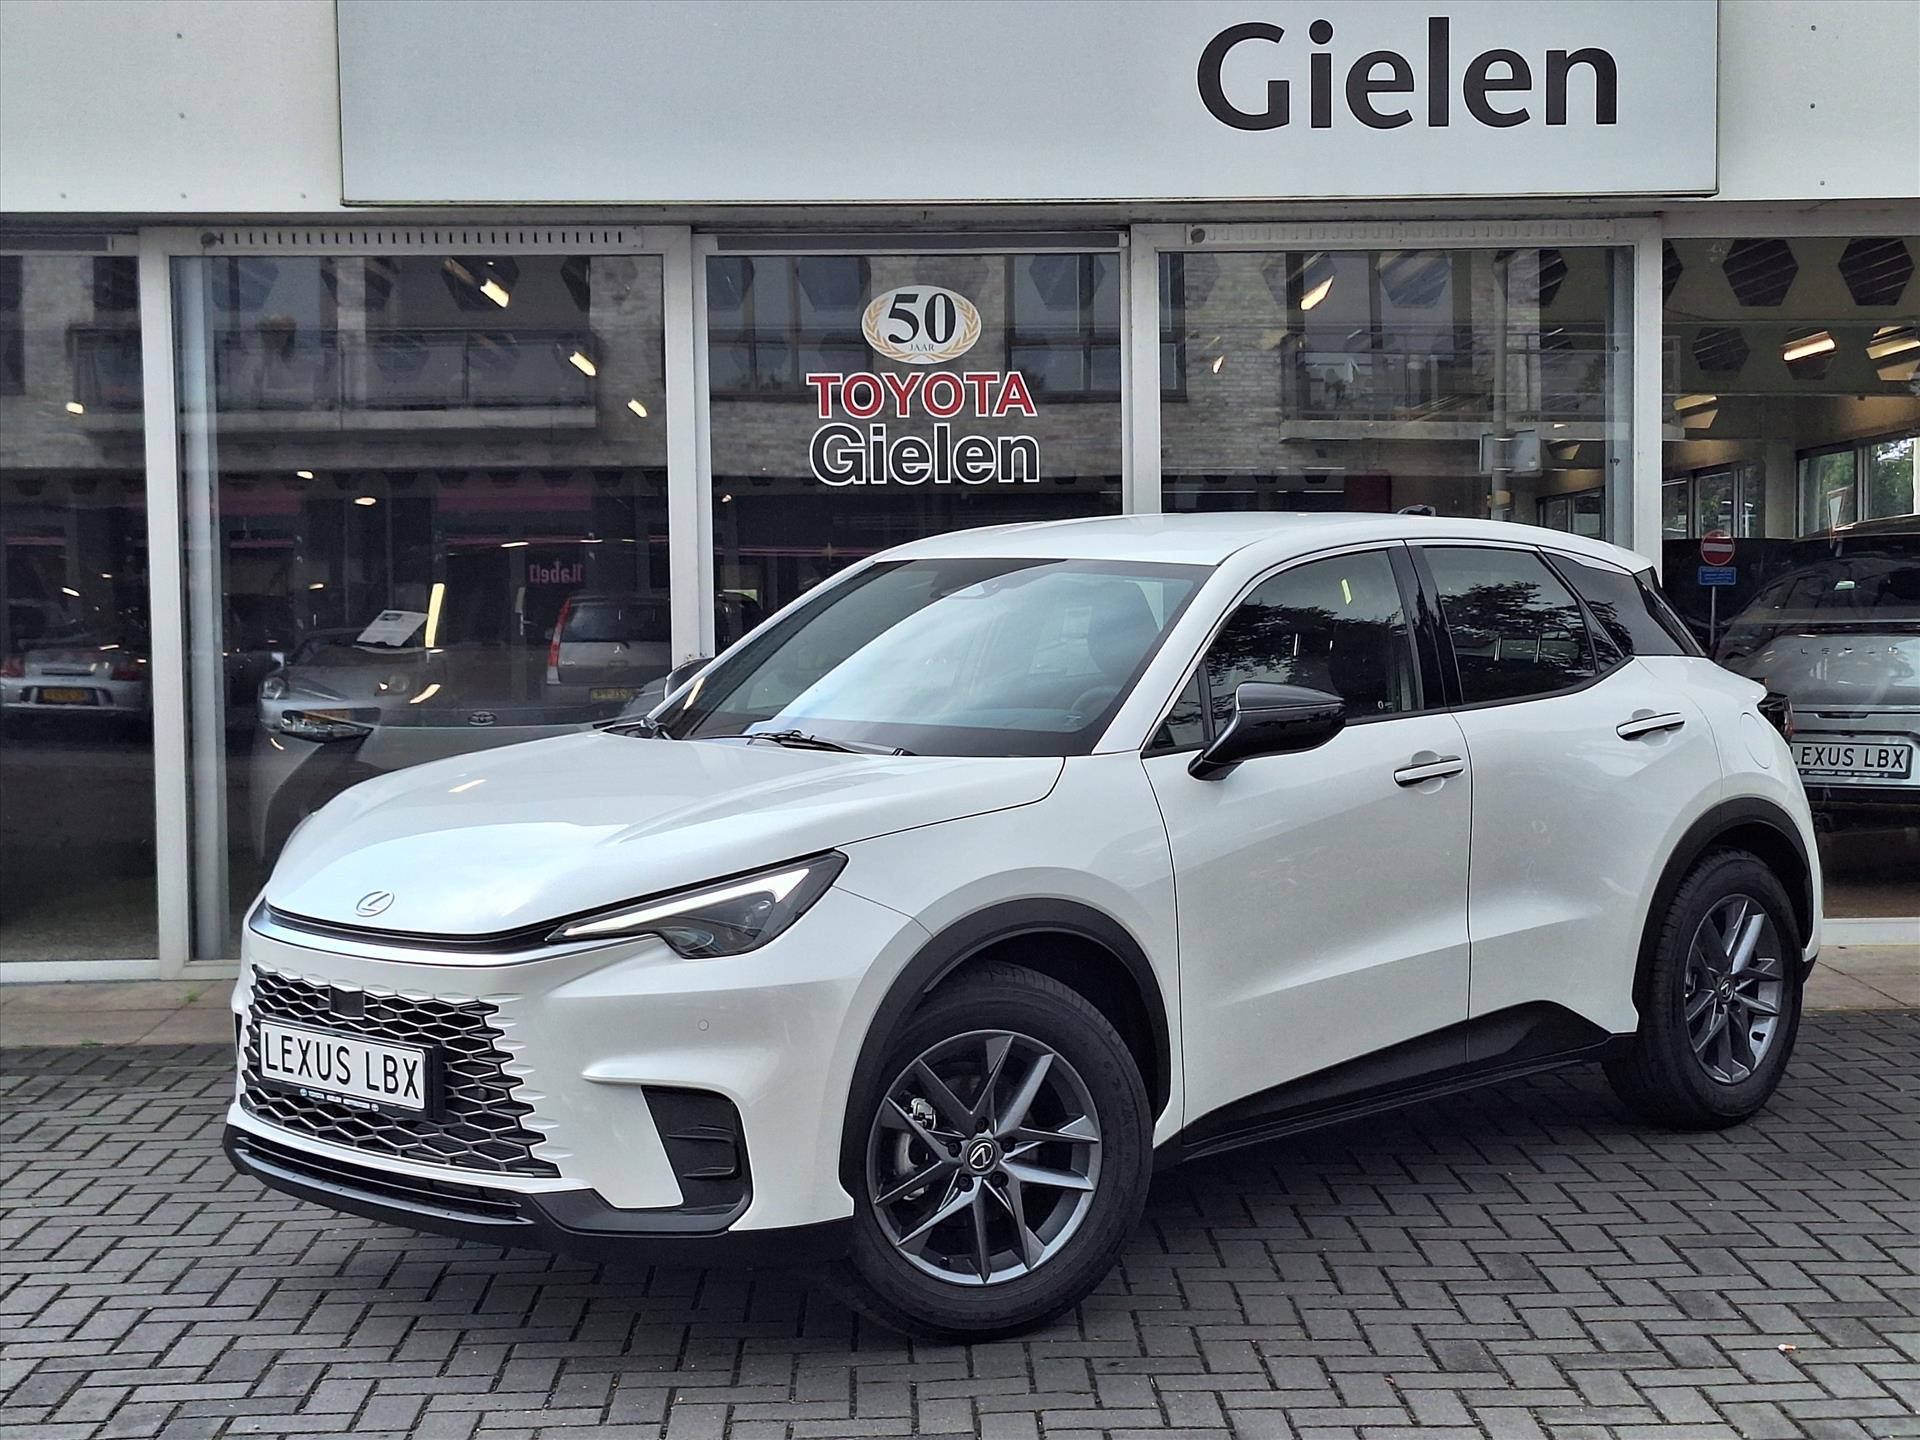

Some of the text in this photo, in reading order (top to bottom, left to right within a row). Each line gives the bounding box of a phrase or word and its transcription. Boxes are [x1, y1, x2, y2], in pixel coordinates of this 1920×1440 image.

[1197, 17, 1617, 131] Gielen
[887, 292, 957, 344] 50
[909, 343, 935, 352] JAAR
[806, 371, 1038, 419] TOYOTA
[809, 422, 1040, 486] Gielen
[1863, 748, 1905, 769] LBX
[265, 1031, 420, 1100] LEXUS LBX
